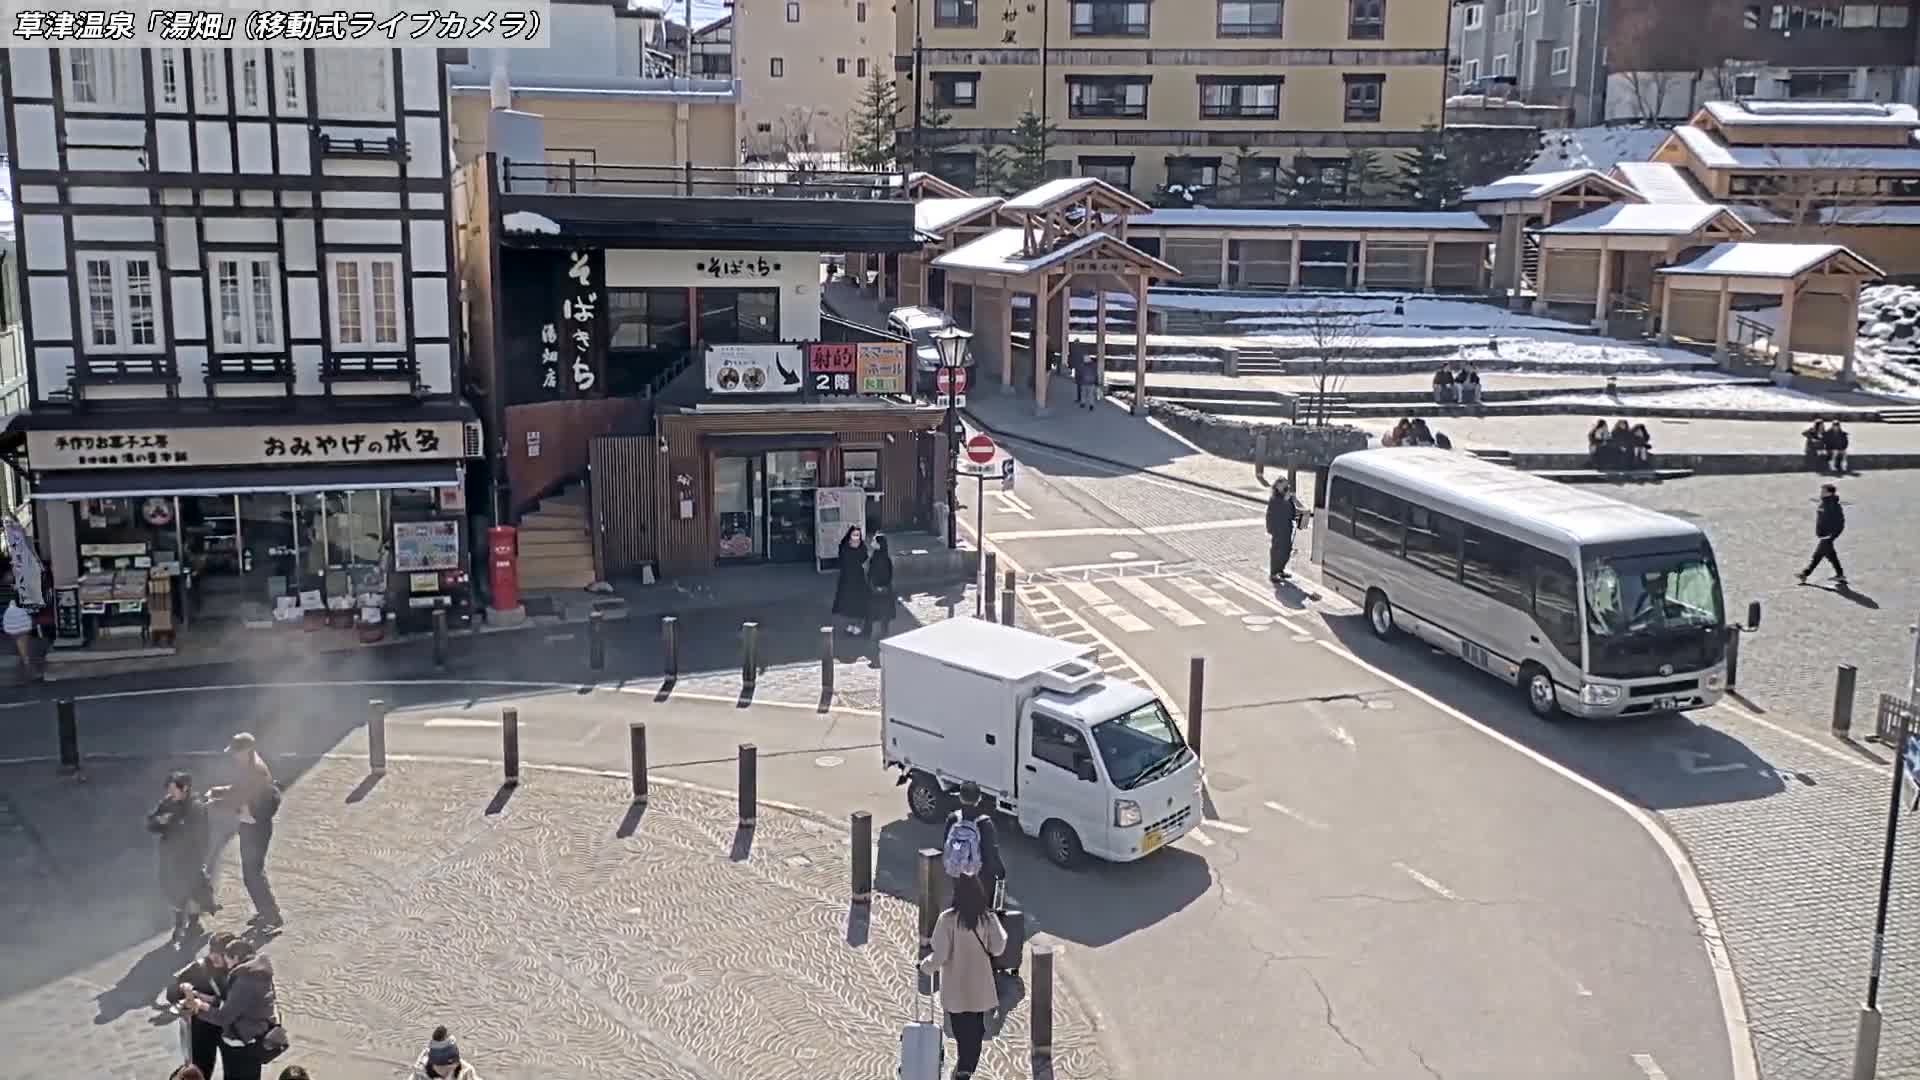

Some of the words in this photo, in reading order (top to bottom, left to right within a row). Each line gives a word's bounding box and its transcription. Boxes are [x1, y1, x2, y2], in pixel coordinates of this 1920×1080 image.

[563, 251, 597, 390] そばきち
[814, 347, 851, 369] 射的
[816, 374, 849, 390] 2階
[56, 434, 168, 450] 手作りお菓子工房
[264, 428, 439, 456] おみやげの本多
